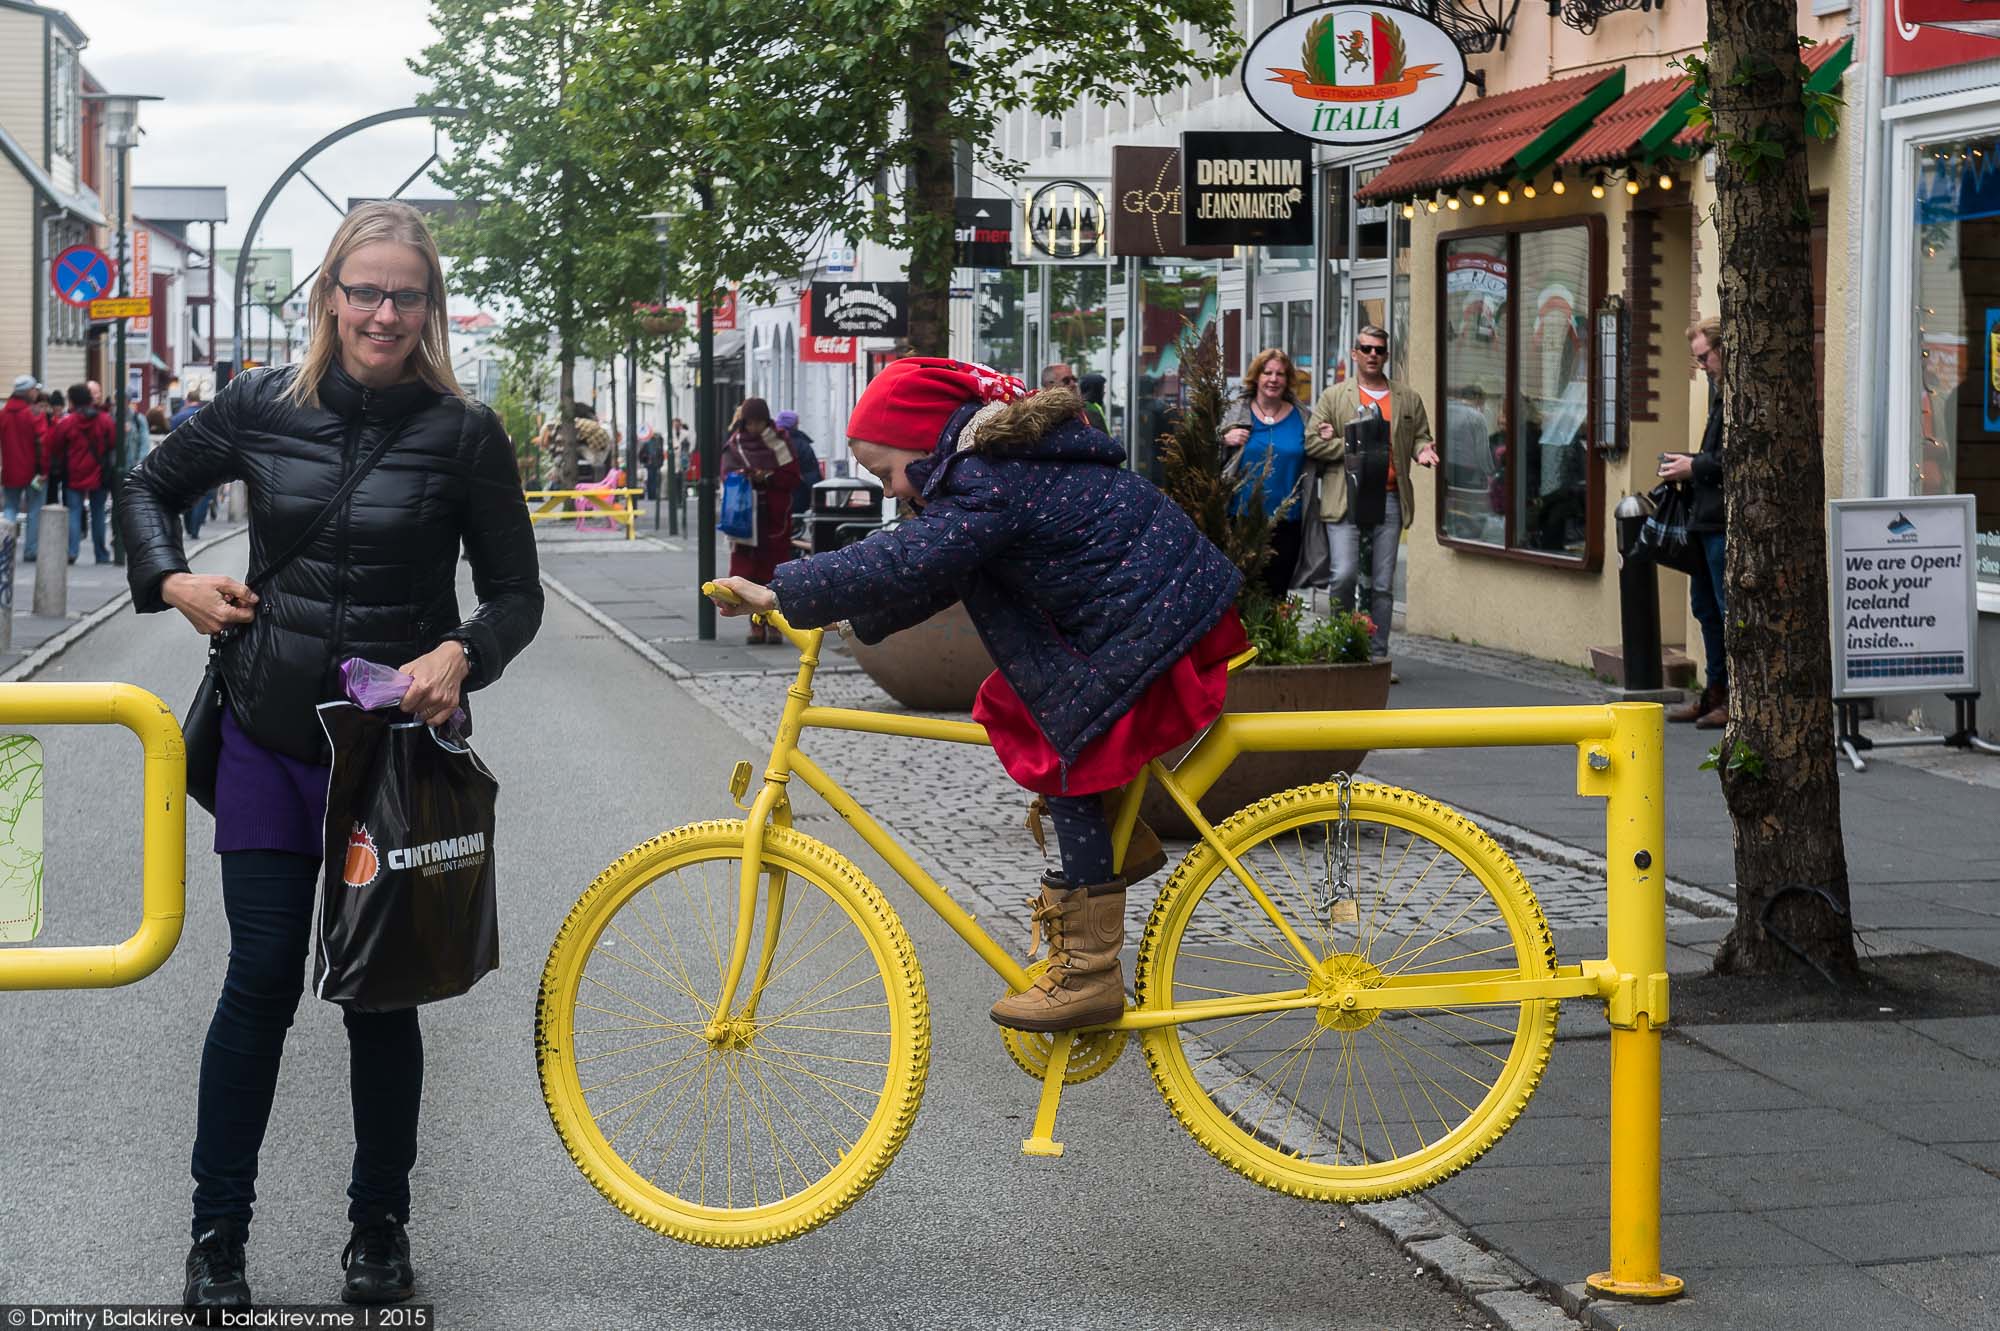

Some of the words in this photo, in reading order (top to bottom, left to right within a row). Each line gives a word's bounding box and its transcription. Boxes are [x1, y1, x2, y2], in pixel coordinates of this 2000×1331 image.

[1311, 101, 1400, 131] ÍTALÍA
[1122, 186, 1182, 215] GOT
[1197, 192, 1292, 219] JEANSMAKERS
[1846, 557, 1873, 571] We
[1877, 558, 1906, 571] are
[1911, 554, 1962, 573] Open!
[1846, 575, 1888, 591] Book
[1891, 576, 1932, 593] your
[1846, 593, 1910, 610] Iceland
[1846, 614, 1936, 630] Adventure
[1847, 633, 1914, 649] inside...
[387, 832, 485, 870] CINTAMANI
